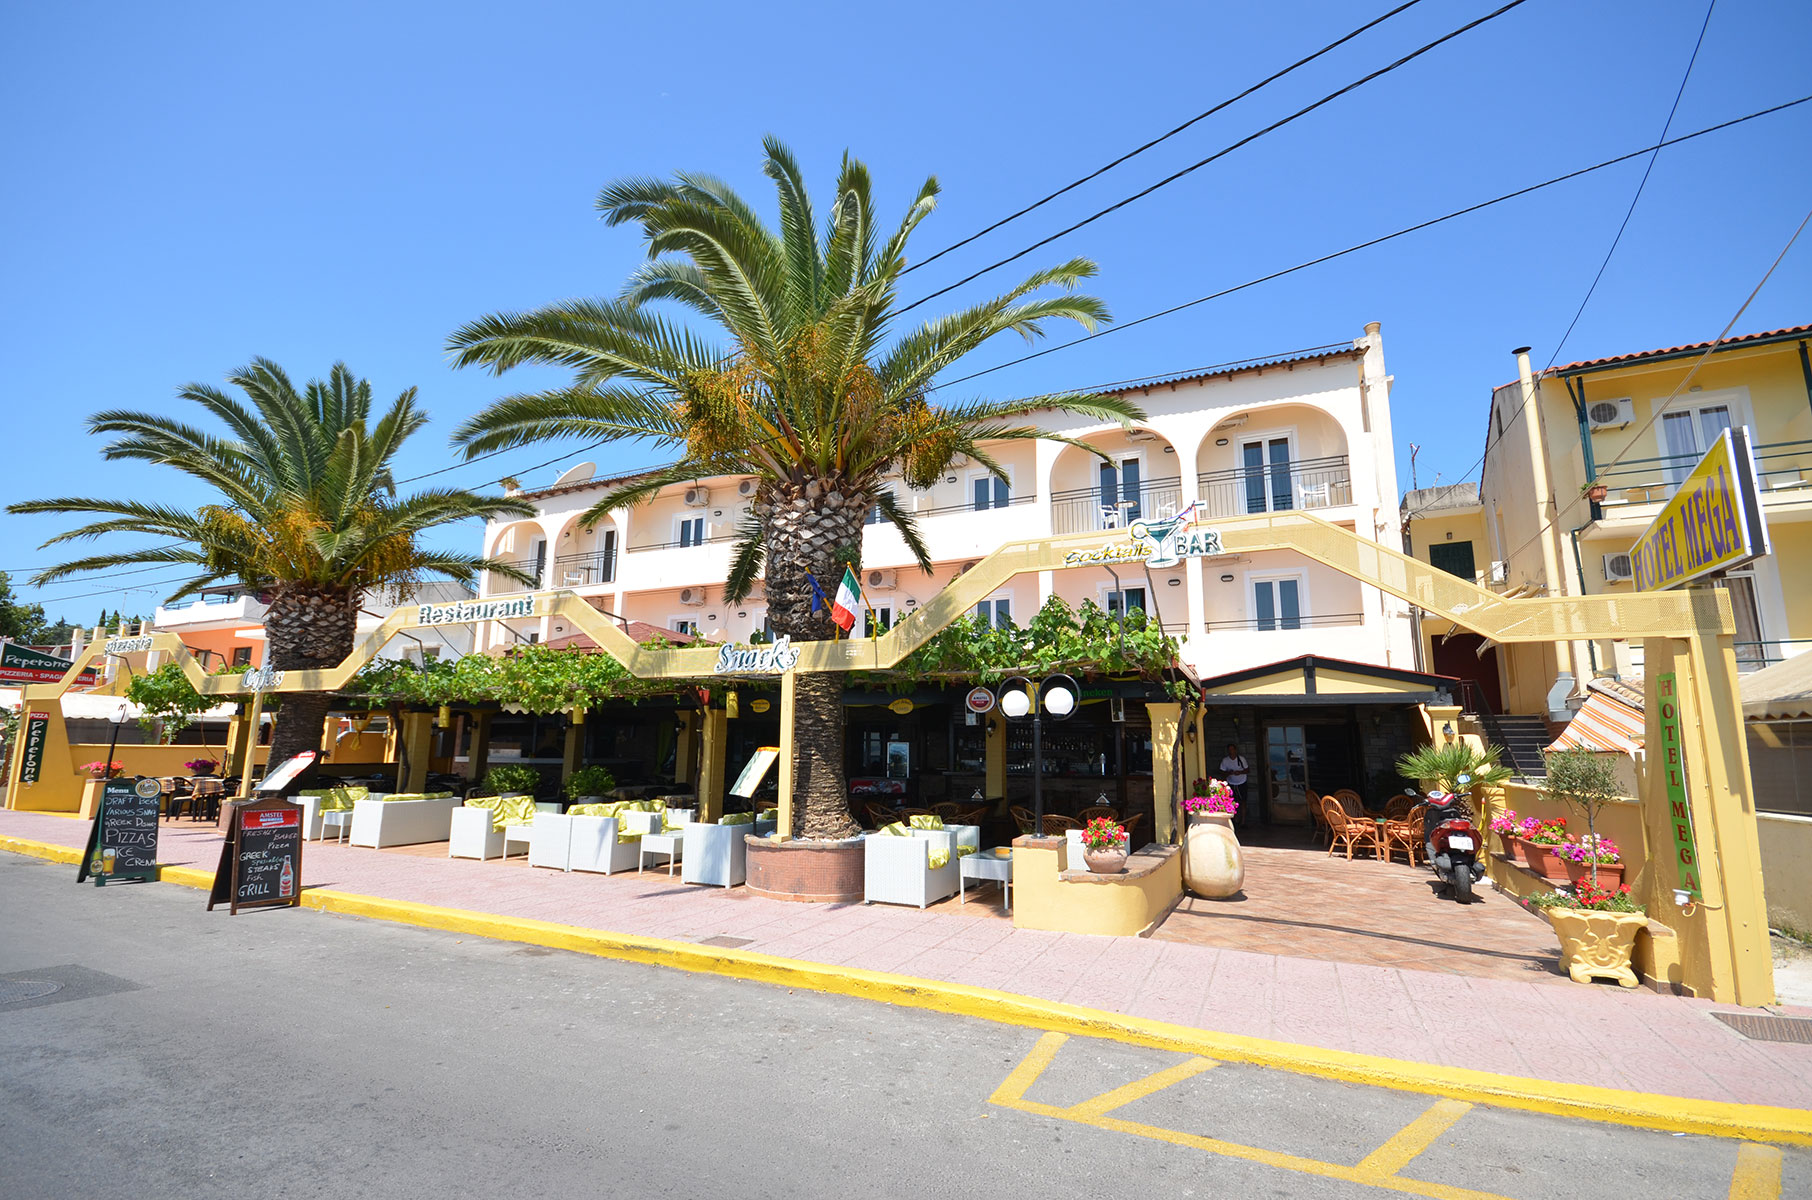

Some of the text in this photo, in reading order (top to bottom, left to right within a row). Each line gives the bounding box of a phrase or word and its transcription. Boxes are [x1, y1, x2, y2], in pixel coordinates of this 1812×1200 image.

[1632, 464, 1741, 591] HOTEL MEGA
[1175, 531, 1219, 556] BAR
[418, 595, 534, 625] Restaurant
[5, 654, 70, 668] Peperone
[714, 635, 800, 673] Snack's
[0, 670, 94, 682] PIZZERIA SPAGHERIA
[24, 721, 44, 781] Peperone
[1660, 679, 1698, 892] HOTEL MEGA
[105, 828, 157, 848] PIZZAS
[115, 846, 134, 859] ICE
[239, 850, 269, 861] GREEK
[238, 882, 270, 897] GRILL
